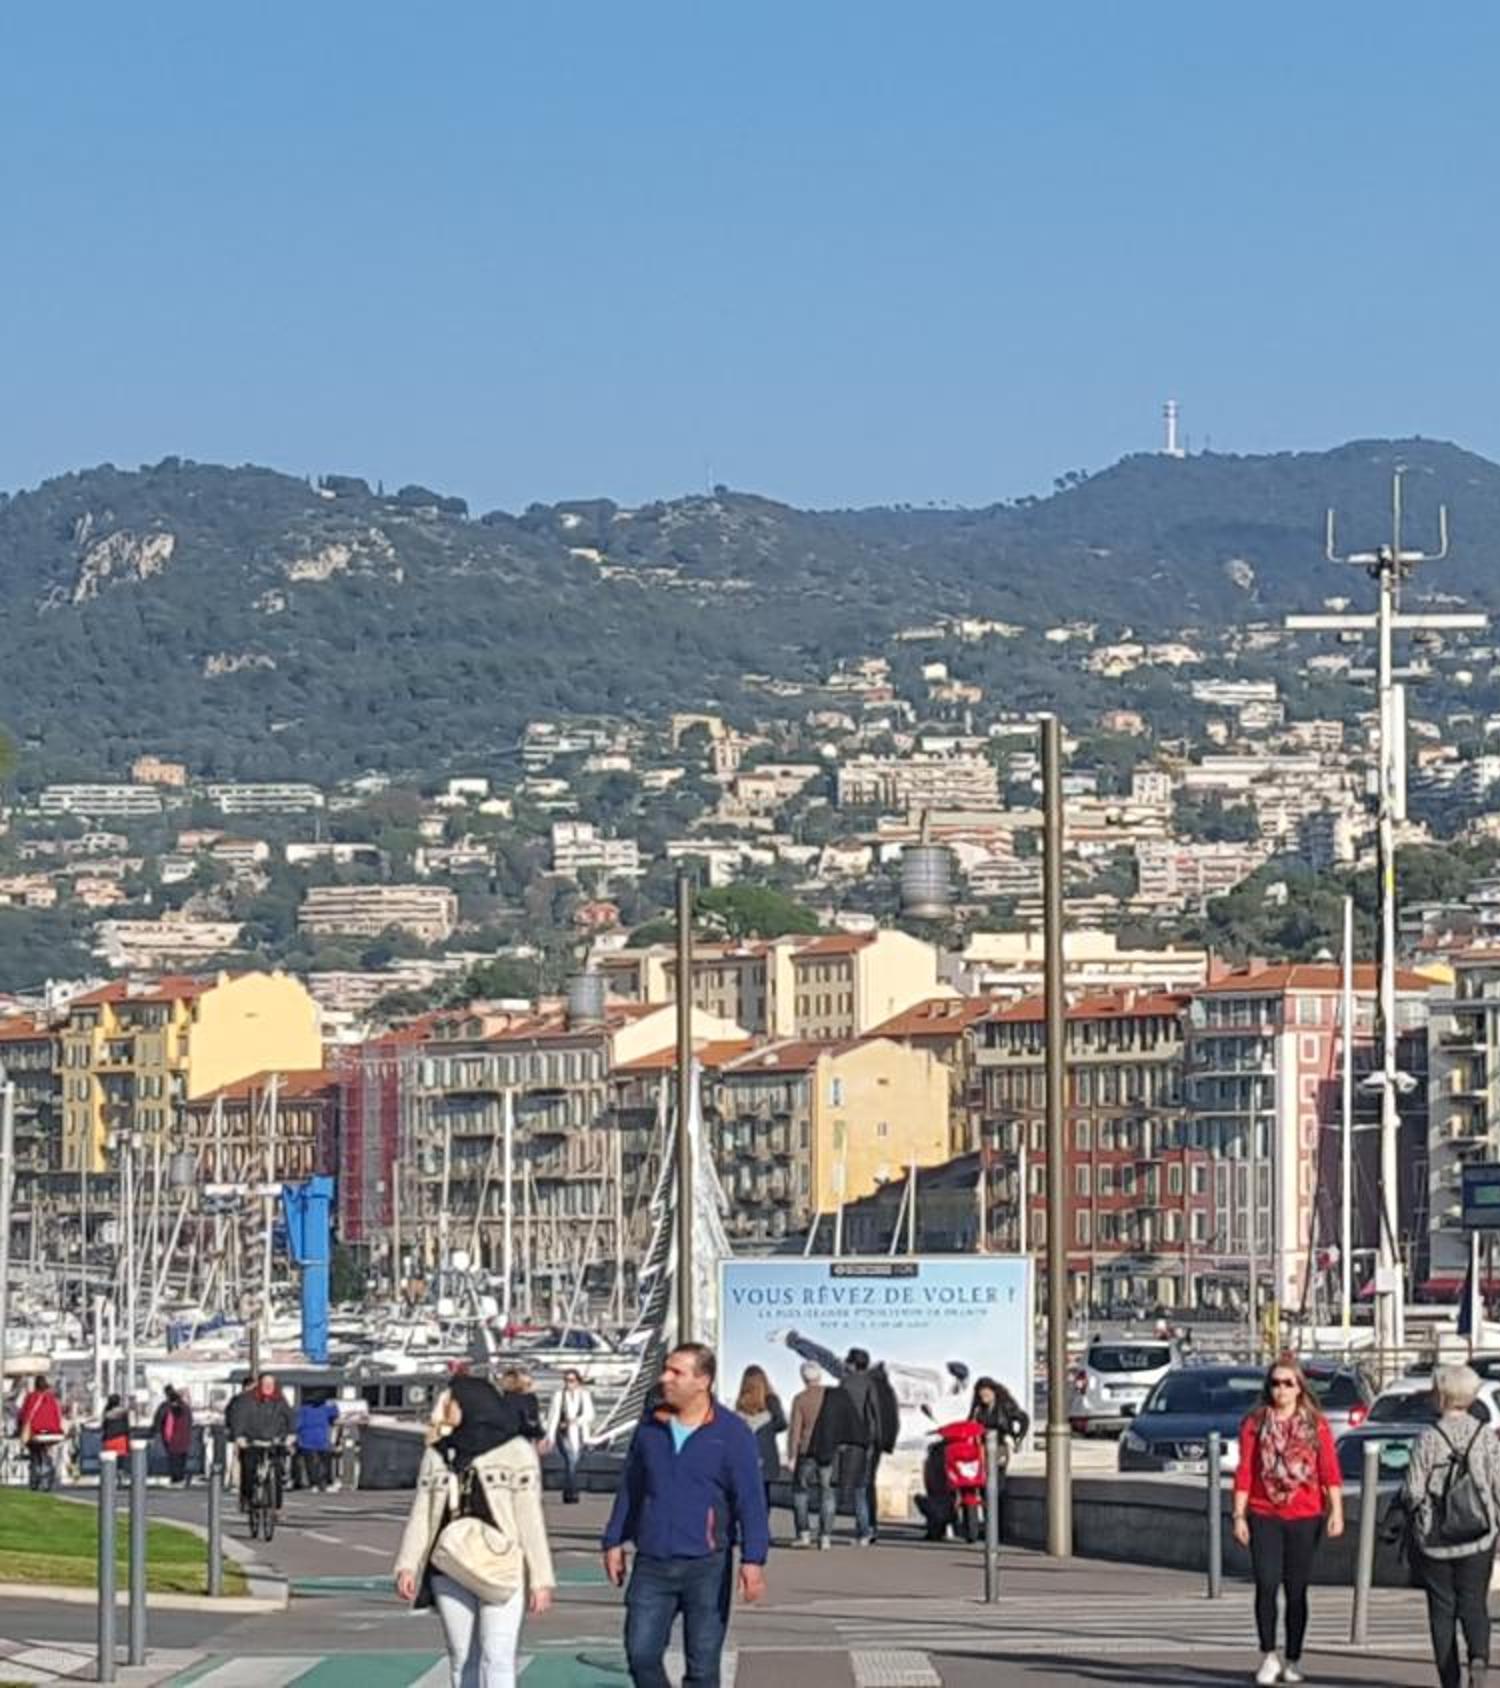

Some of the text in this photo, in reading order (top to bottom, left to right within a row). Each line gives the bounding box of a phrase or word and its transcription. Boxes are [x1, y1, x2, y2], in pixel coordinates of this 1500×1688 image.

[732, 1287, 794, 1305] VOUS
[802, 1284, 875, 1305] RÊVEZ
[884, 1286, 913, 1304] DE
[923, 1286, 999, 1304] VOLER
